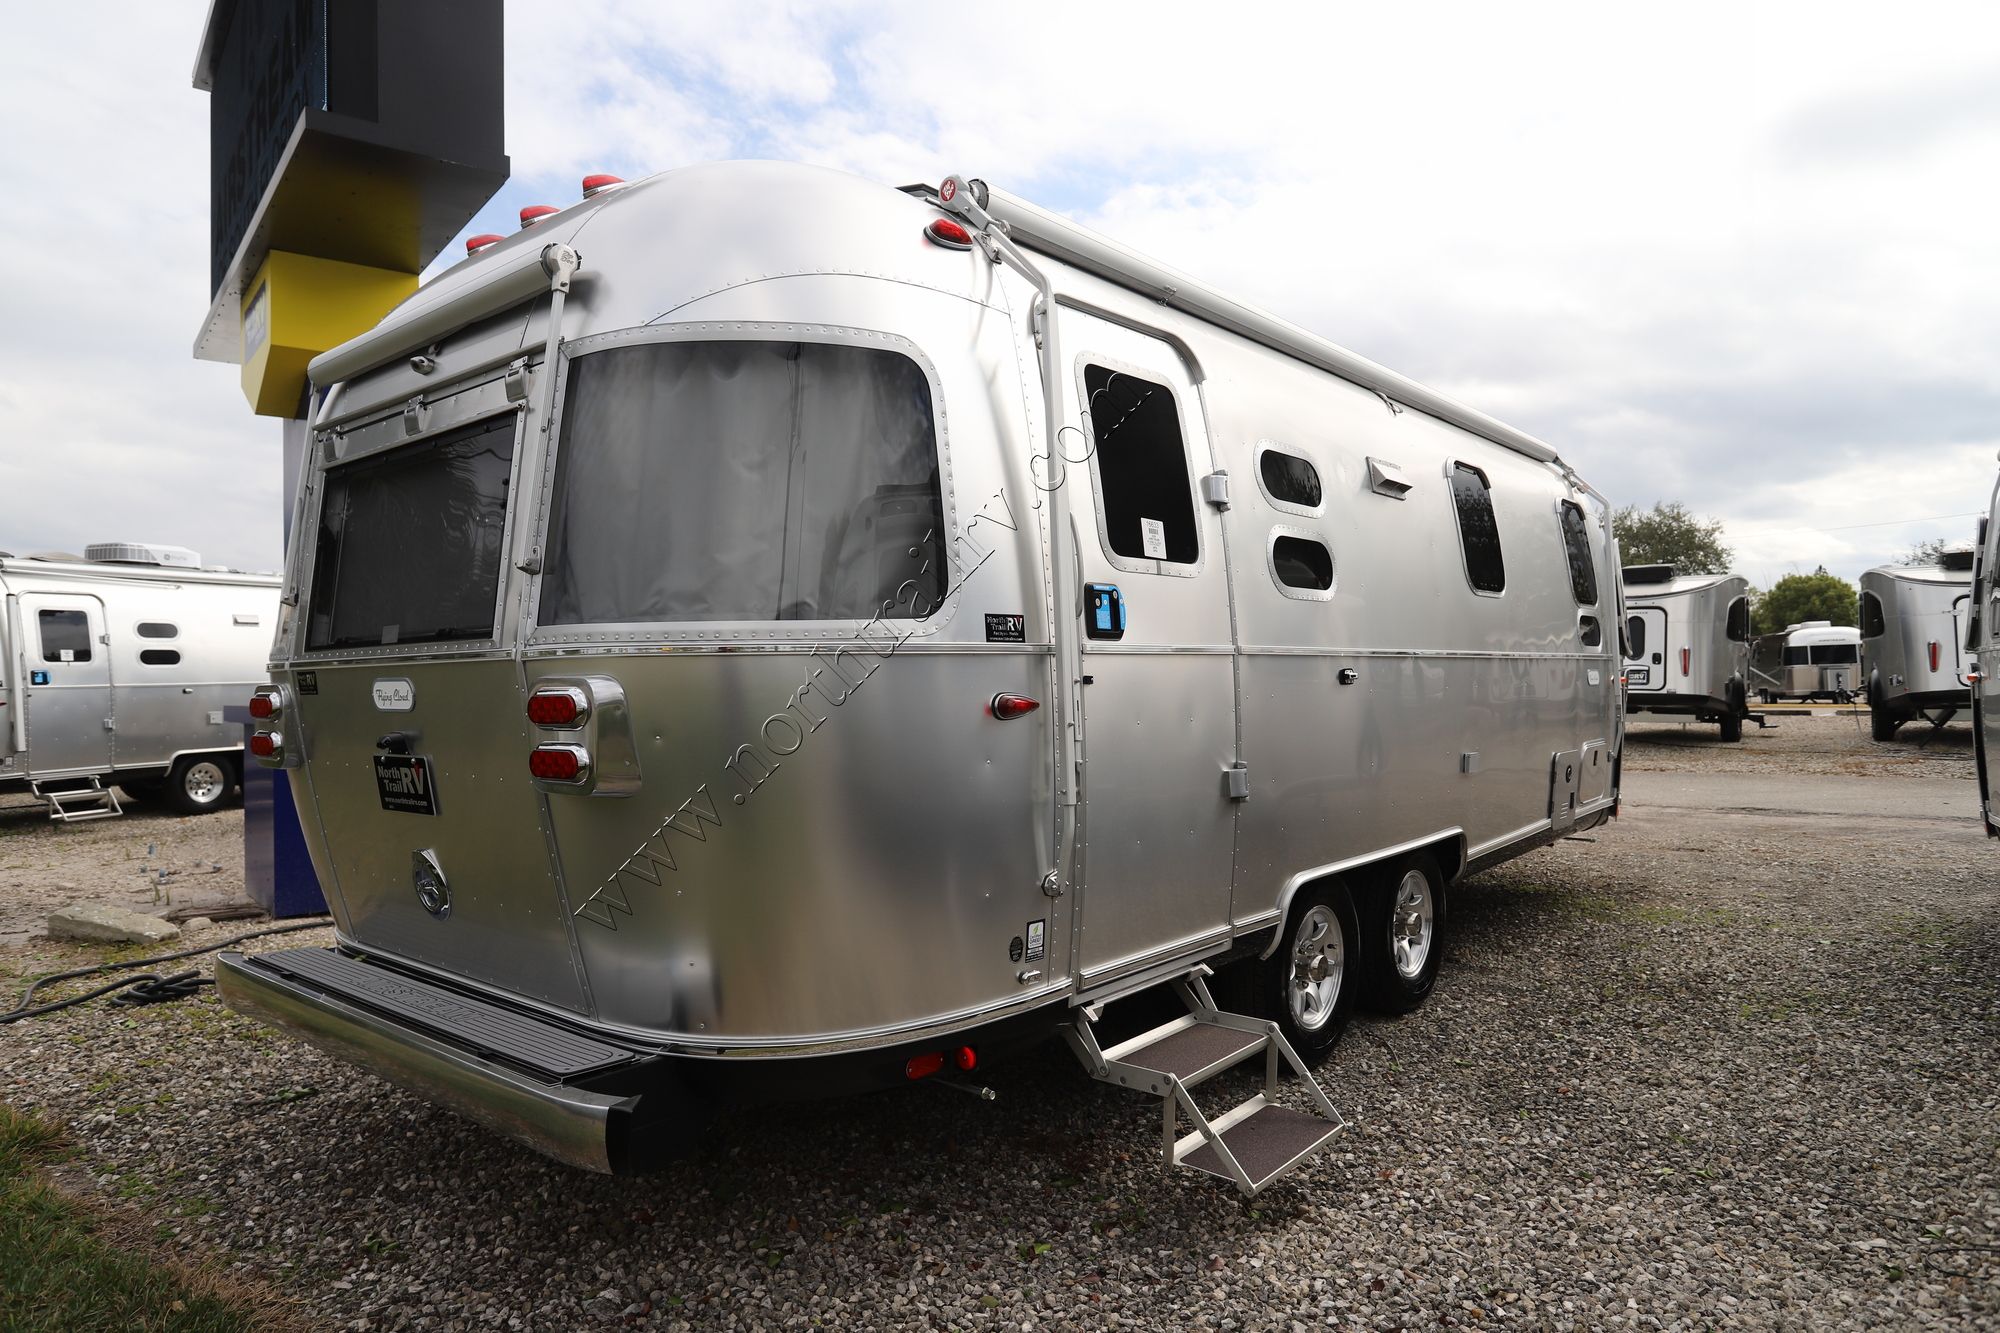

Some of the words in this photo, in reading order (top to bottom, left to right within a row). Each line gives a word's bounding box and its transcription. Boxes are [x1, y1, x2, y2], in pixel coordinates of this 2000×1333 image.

[1007, 617, 1023, 631] RV
[376, 688, 393, 706] Flying
[393, 688, 410, 702] Cloud
[377, 765, 401, 780] North
[400, 767, 424, 795] RV
[384, 779, 403, 793] Trail
